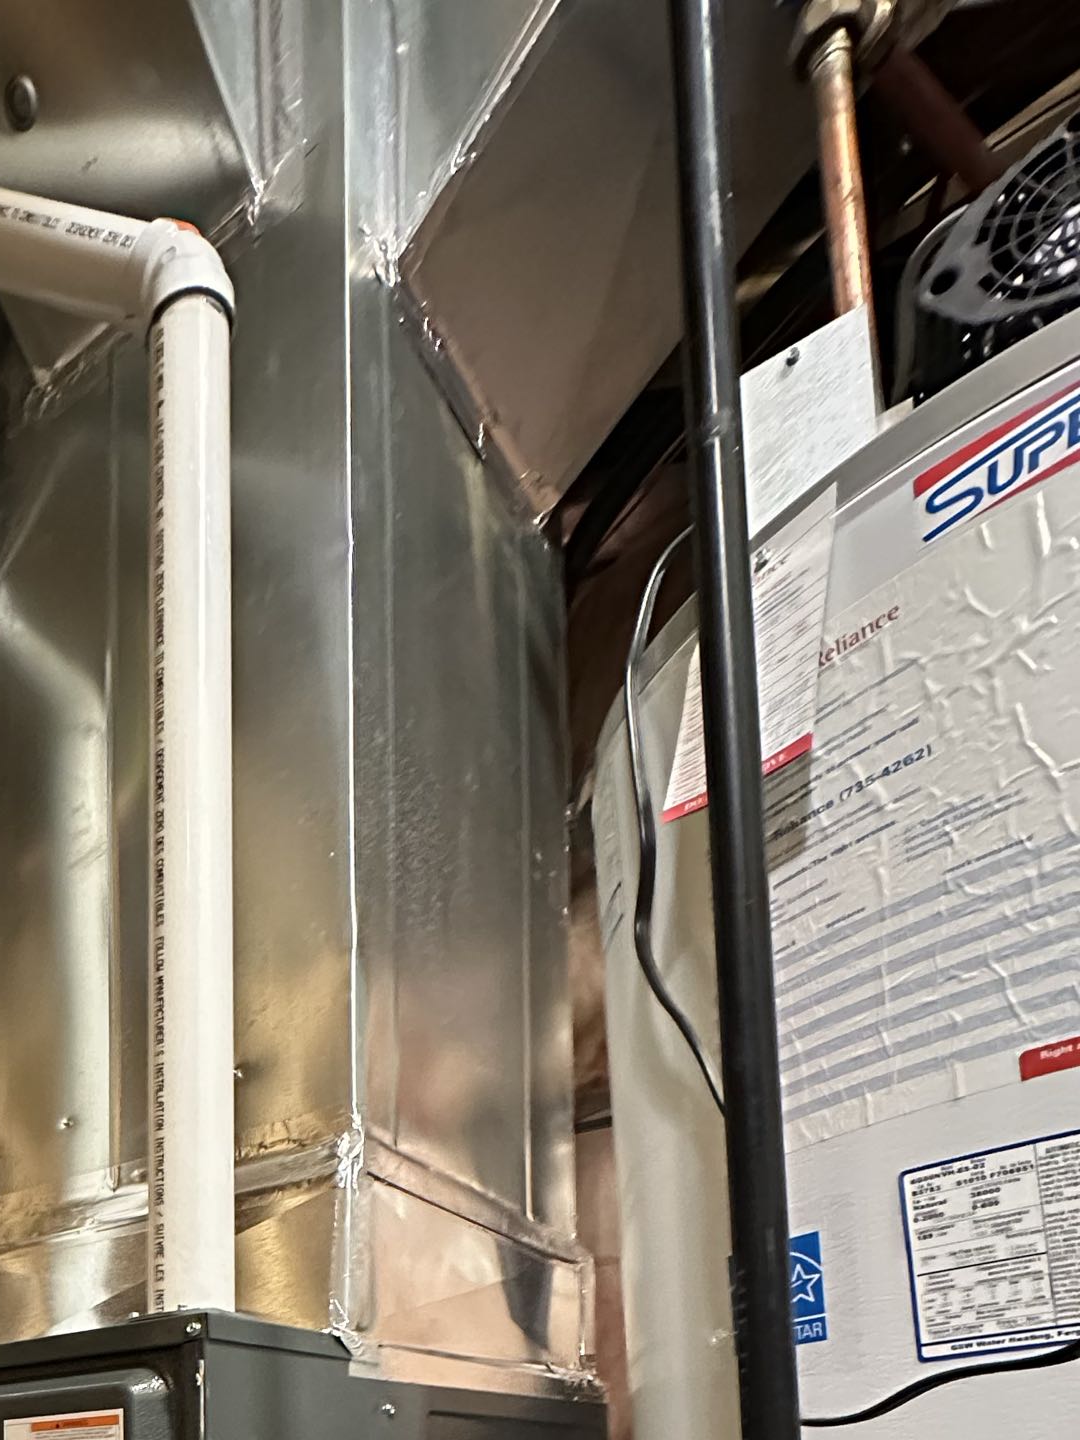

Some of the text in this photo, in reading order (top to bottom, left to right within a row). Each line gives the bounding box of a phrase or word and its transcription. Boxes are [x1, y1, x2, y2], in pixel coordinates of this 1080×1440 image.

[154, 667, 165, 736] COMBUSTIBLES
[839, 744, 932, 802] (735-4262)
[154, 857, 165, 927] COMBUSTIBLES
[154, 935, 165, 972] FOLLOW
[154, 975, 165, 1057] MANUFACTURER'S
[154, 1062, 165, 1132] INSTALLATION
[154, 1136, 165, 1206] INSTRUCTIONS
[154, 1223, 165, 1259] SUIVRE
[154, 1264, 165, 1282] LES
[793, 1321, 823, 1340] TAR
